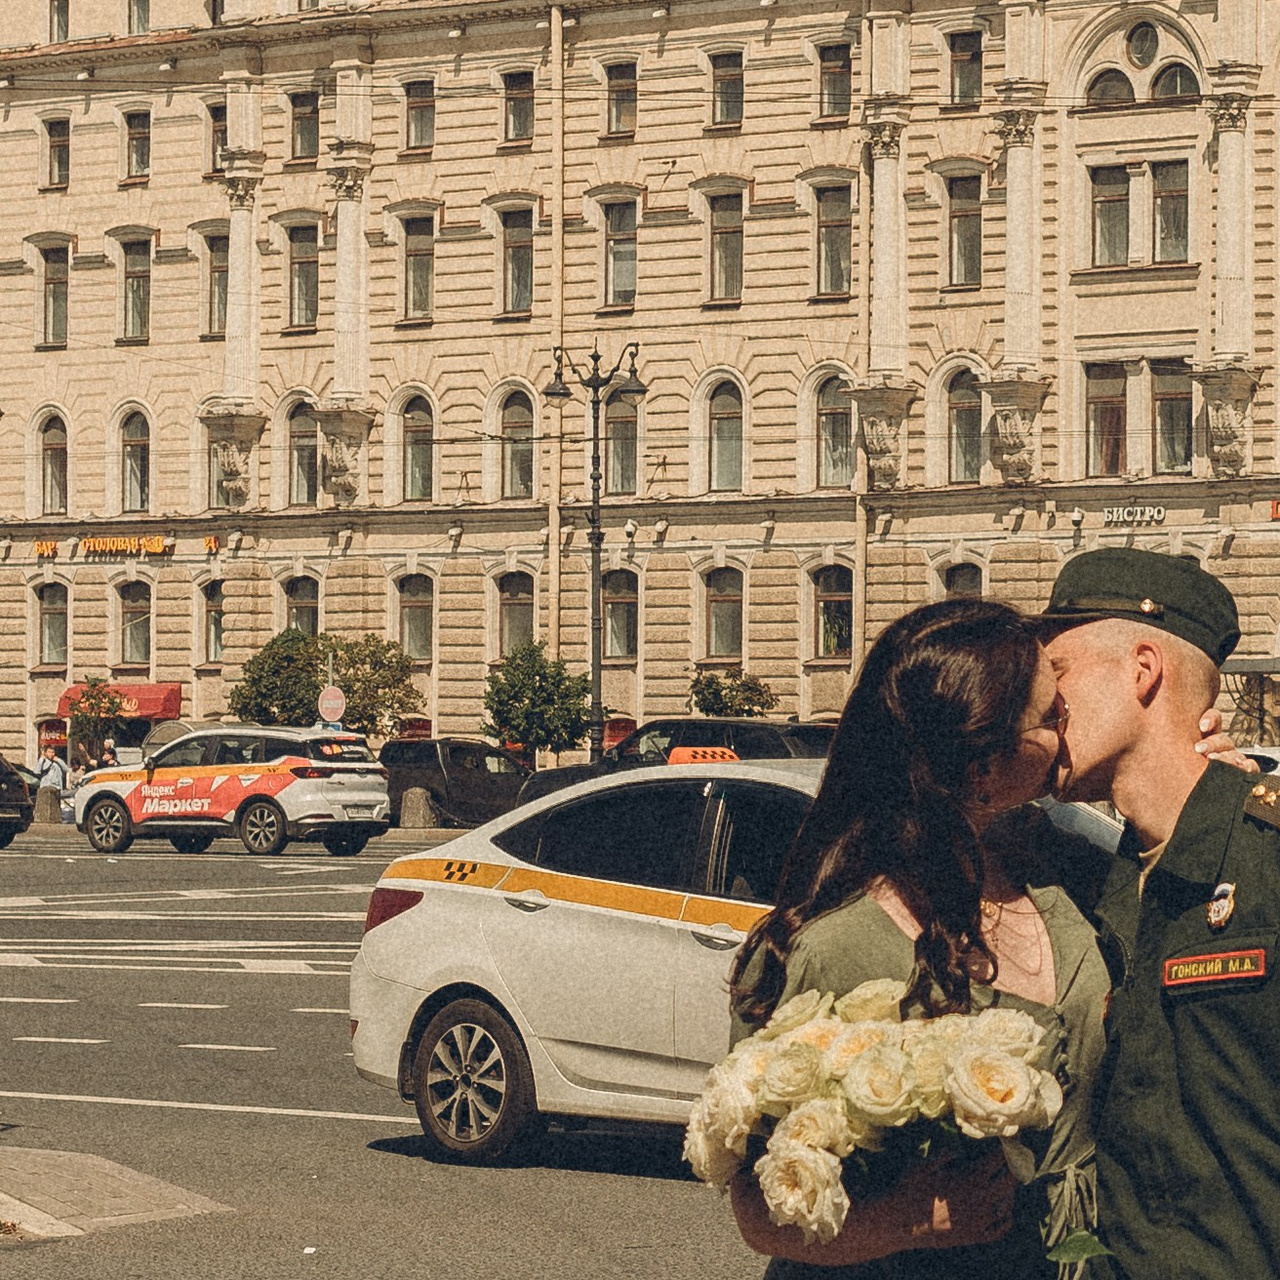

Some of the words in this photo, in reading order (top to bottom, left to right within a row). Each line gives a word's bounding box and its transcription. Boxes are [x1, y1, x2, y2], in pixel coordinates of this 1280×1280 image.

[1103, 506, 1166, 522] БИСТРО
[82, 536, 139, 552] СТОЛОВАЯ
[141, 784, 176, 797] Яндекс
[142, 797, 212, 814] Маркет
[1228, 958, 1256, 972] М.А.
